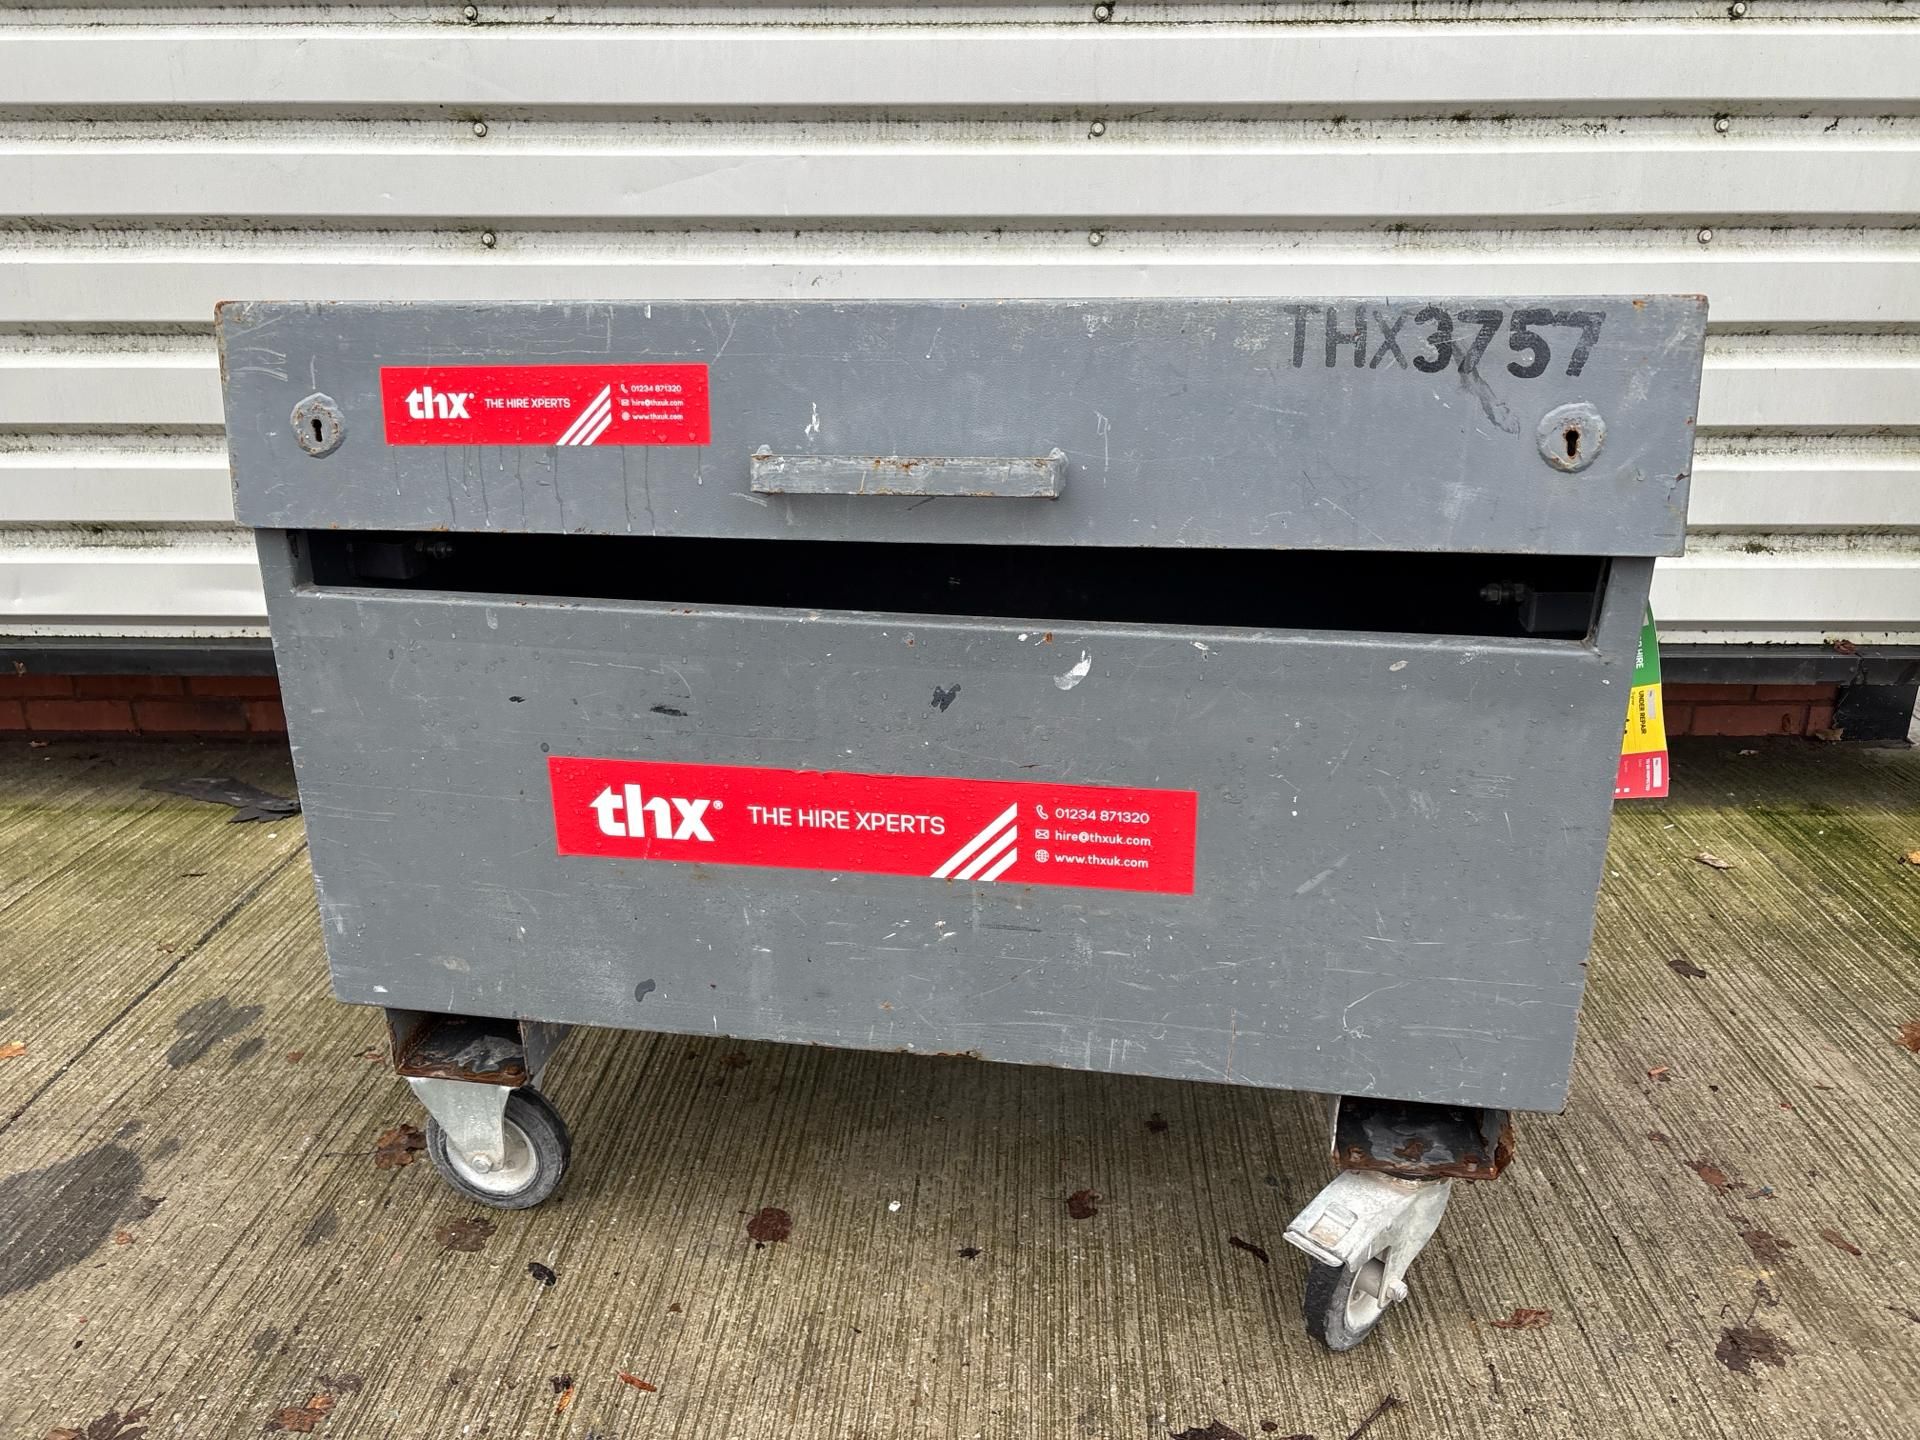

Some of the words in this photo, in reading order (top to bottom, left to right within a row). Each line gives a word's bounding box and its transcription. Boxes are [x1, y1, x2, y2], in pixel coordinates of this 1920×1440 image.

[1283, 304, 1606, 379] THX3757
[485, 397, 504, 408] THE
[507, 397, 529, 408] HIRE
[531, 398, 570, 409] XPERTS
[1638, 690, 1646, 711] UNDER
[1639, 712, 1647, 735] REPAIR
[748, 806, 793, 827] THE
[798, 810, 849, 830] HIRE
[855, 812, 946, 836] XPERTS
[1055, 807, 1097, 822] 01234
[1100, 809, 1149, 825] 871320
[1055, 830, 1151, 846] hire@thxuk.com
[1054, 854, 1149, 868] www.thxuk.com
